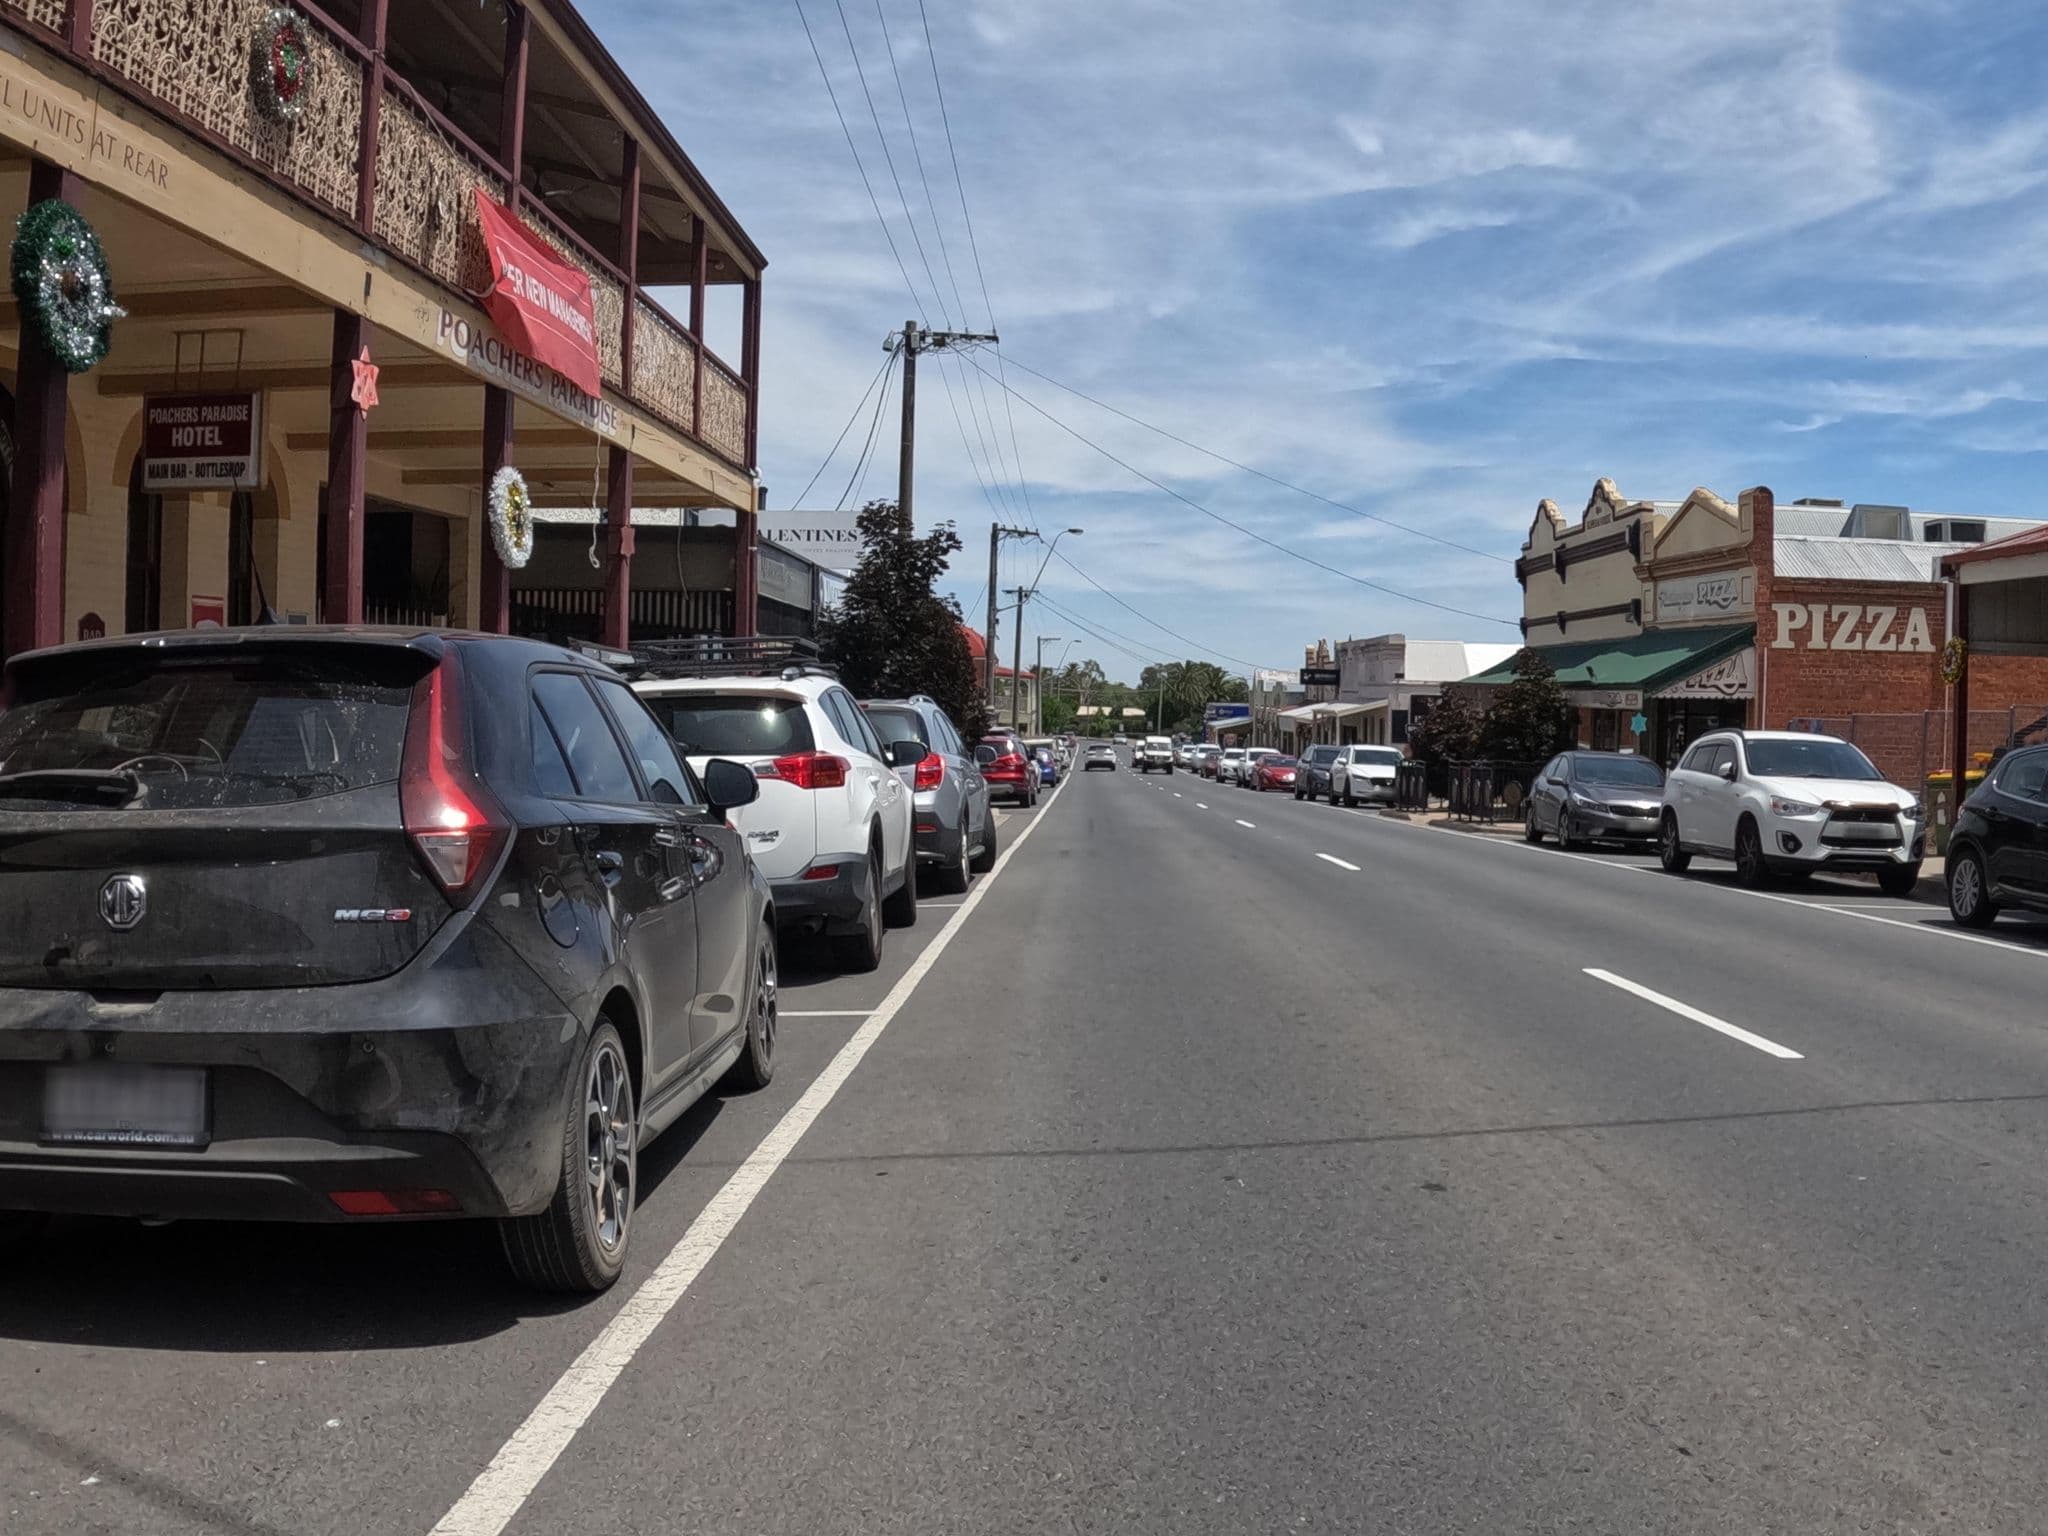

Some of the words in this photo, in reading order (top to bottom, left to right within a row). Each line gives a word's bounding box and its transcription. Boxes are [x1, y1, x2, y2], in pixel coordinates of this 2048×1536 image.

[22, 89, 85, 144] UNITS
[91, 131, 117, 160] AT
[123, 145, 169, 190] REAR
[438, 309, 545, 390] POACHERS
[551, 373, 618, 430] PARADISE
[149, 407, 199, 424] POACHERS
[201, 405, 249, 422] PARADISE
[171, 426, 222, 447] HOTEL
[148, 464, 169, 479] MAIN
[170, 463, 187, 479] BAR
[195, 461, 246, 478] BOTTLESHOP
[1696, 578, 1738, 609] PIZZA
[1771, 603, 1937, 652] PIZZA
